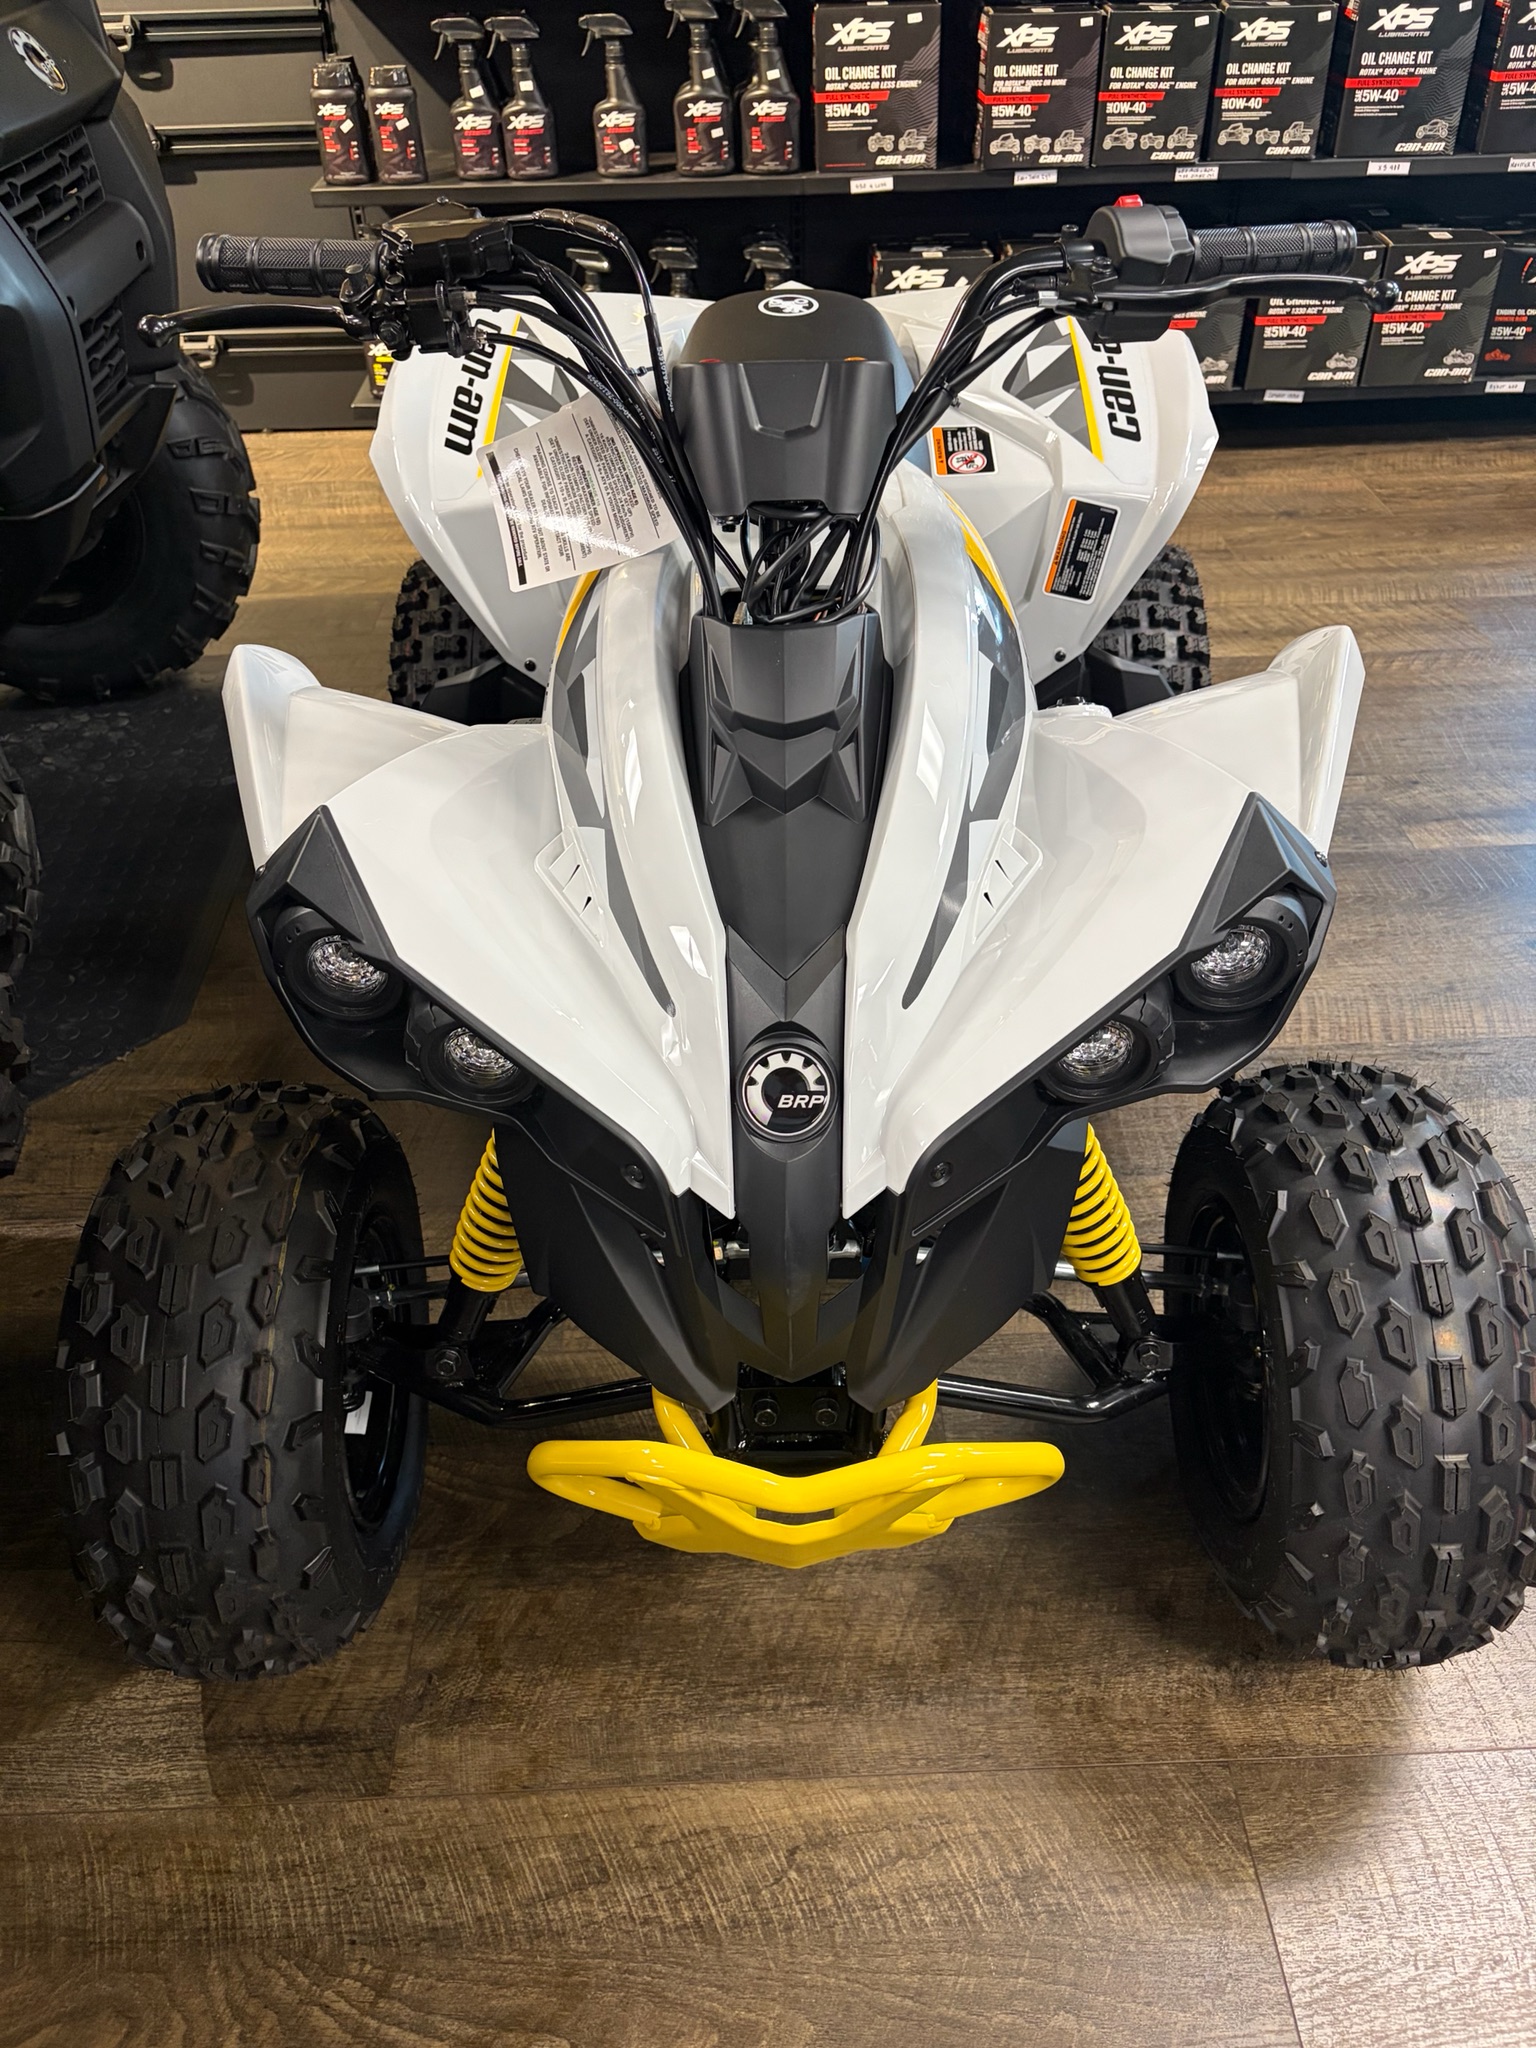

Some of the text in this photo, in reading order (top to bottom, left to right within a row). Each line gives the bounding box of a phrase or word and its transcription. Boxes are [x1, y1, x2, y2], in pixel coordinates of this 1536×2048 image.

[1367, 3, 1439, 30] XPS
[825, 17, 895, 45] XPS
[996, 23, 1059, 47] XPS
[1114, 21, 1177, 45] XPS
[1231, 17, 1295, 41] XPS
[1361, 51, 1433, 65] OIL CHANGE KIT
[1510, 45, 1525, 58] OIL
[825, 65, 897, 80] OIL CHANGE KIT
[994, 64, 1058, 77] OIL CHANGE KIT
[1110, 67, 1174, 79] OIL CHANGE KIT
[1226, 62, 1291, 75] OIL CHANGE KIT
[1362, 89, 1398, 102] 5W-40
[317, 103, 347, 116] XPS
[375, 102, 404, 115] XPS
[684, 100, 723, 117] XPS
[749, 100, 788, 115] XPS
[833, 103, 869, 116] 5W-40
[998, 105, 1031, 116] 5W-40
[1114, 102, 1146, 113] 0W-40
[1229, 98, 1262, 109] 0W-40
[455, 114, 493, 130] XPS
[507, 113, 545, 129] XPS
[598, 111, 636, 127] XPS
[1394, 251, 1462, 275] XPS
[885, 266, 949, 289] XPS
[1405, 290, 1441, 302] CHANGE
[1441, 290, 1456, 300] KIT
[1271, 326, 1306, 337] 5W-40
[1390, 322, 1424, 334] 5W-40
[1497, 327, 1526, 336] 5W-40
[587, 490, 595, 506] UNDER
[539, 537, 547, 551] ABOUT
[560, 536, 569, 552] SKILLS
[1055, 530, 1066, 560] WARNING
[778, 1095, 824, 1108] BRP
